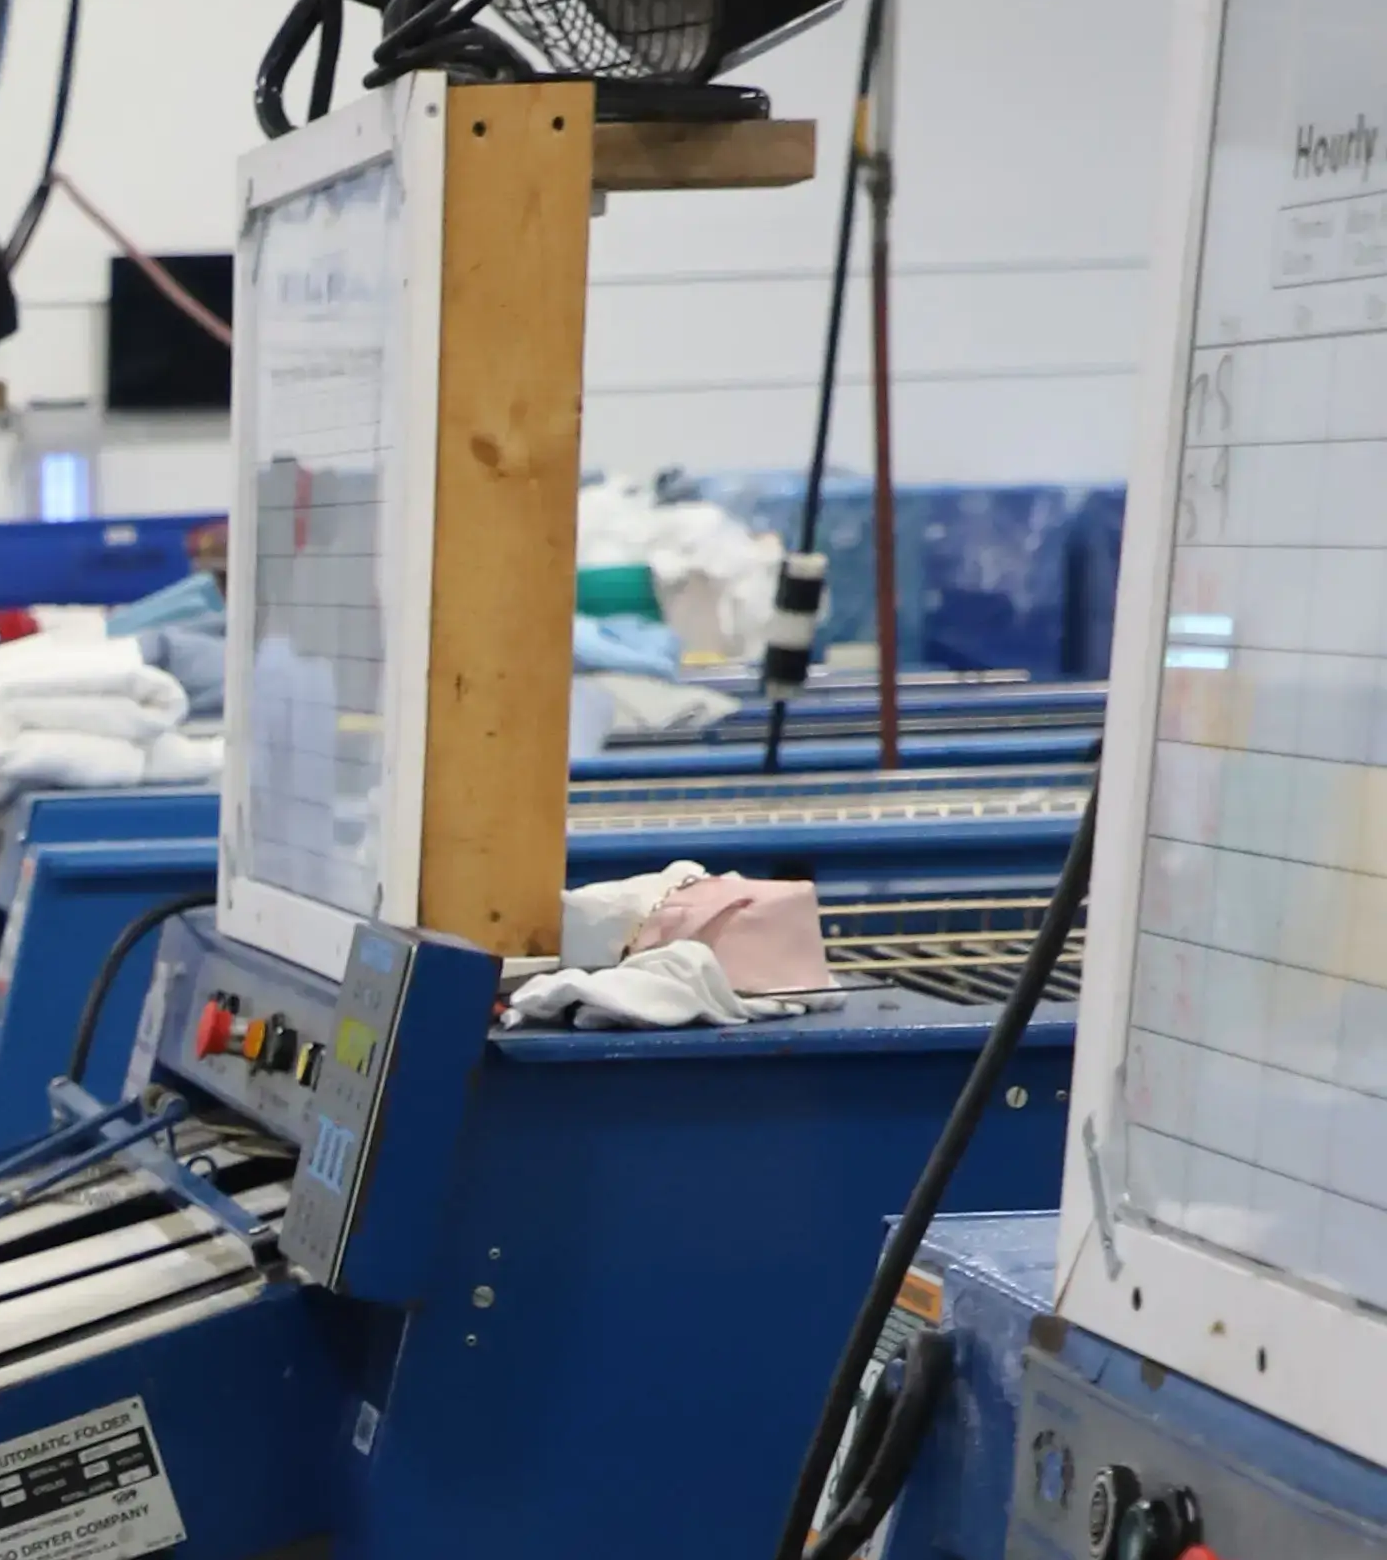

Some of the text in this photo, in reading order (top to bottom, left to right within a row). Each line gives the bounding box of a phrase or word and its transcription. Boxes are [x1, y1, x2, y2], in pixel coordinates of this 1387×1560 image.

[75, 1412, 133, 1442] FOLDER
[21, 1529, 74, 1558] DRYER
[75, 1504, 151, 1539] COMPANY
